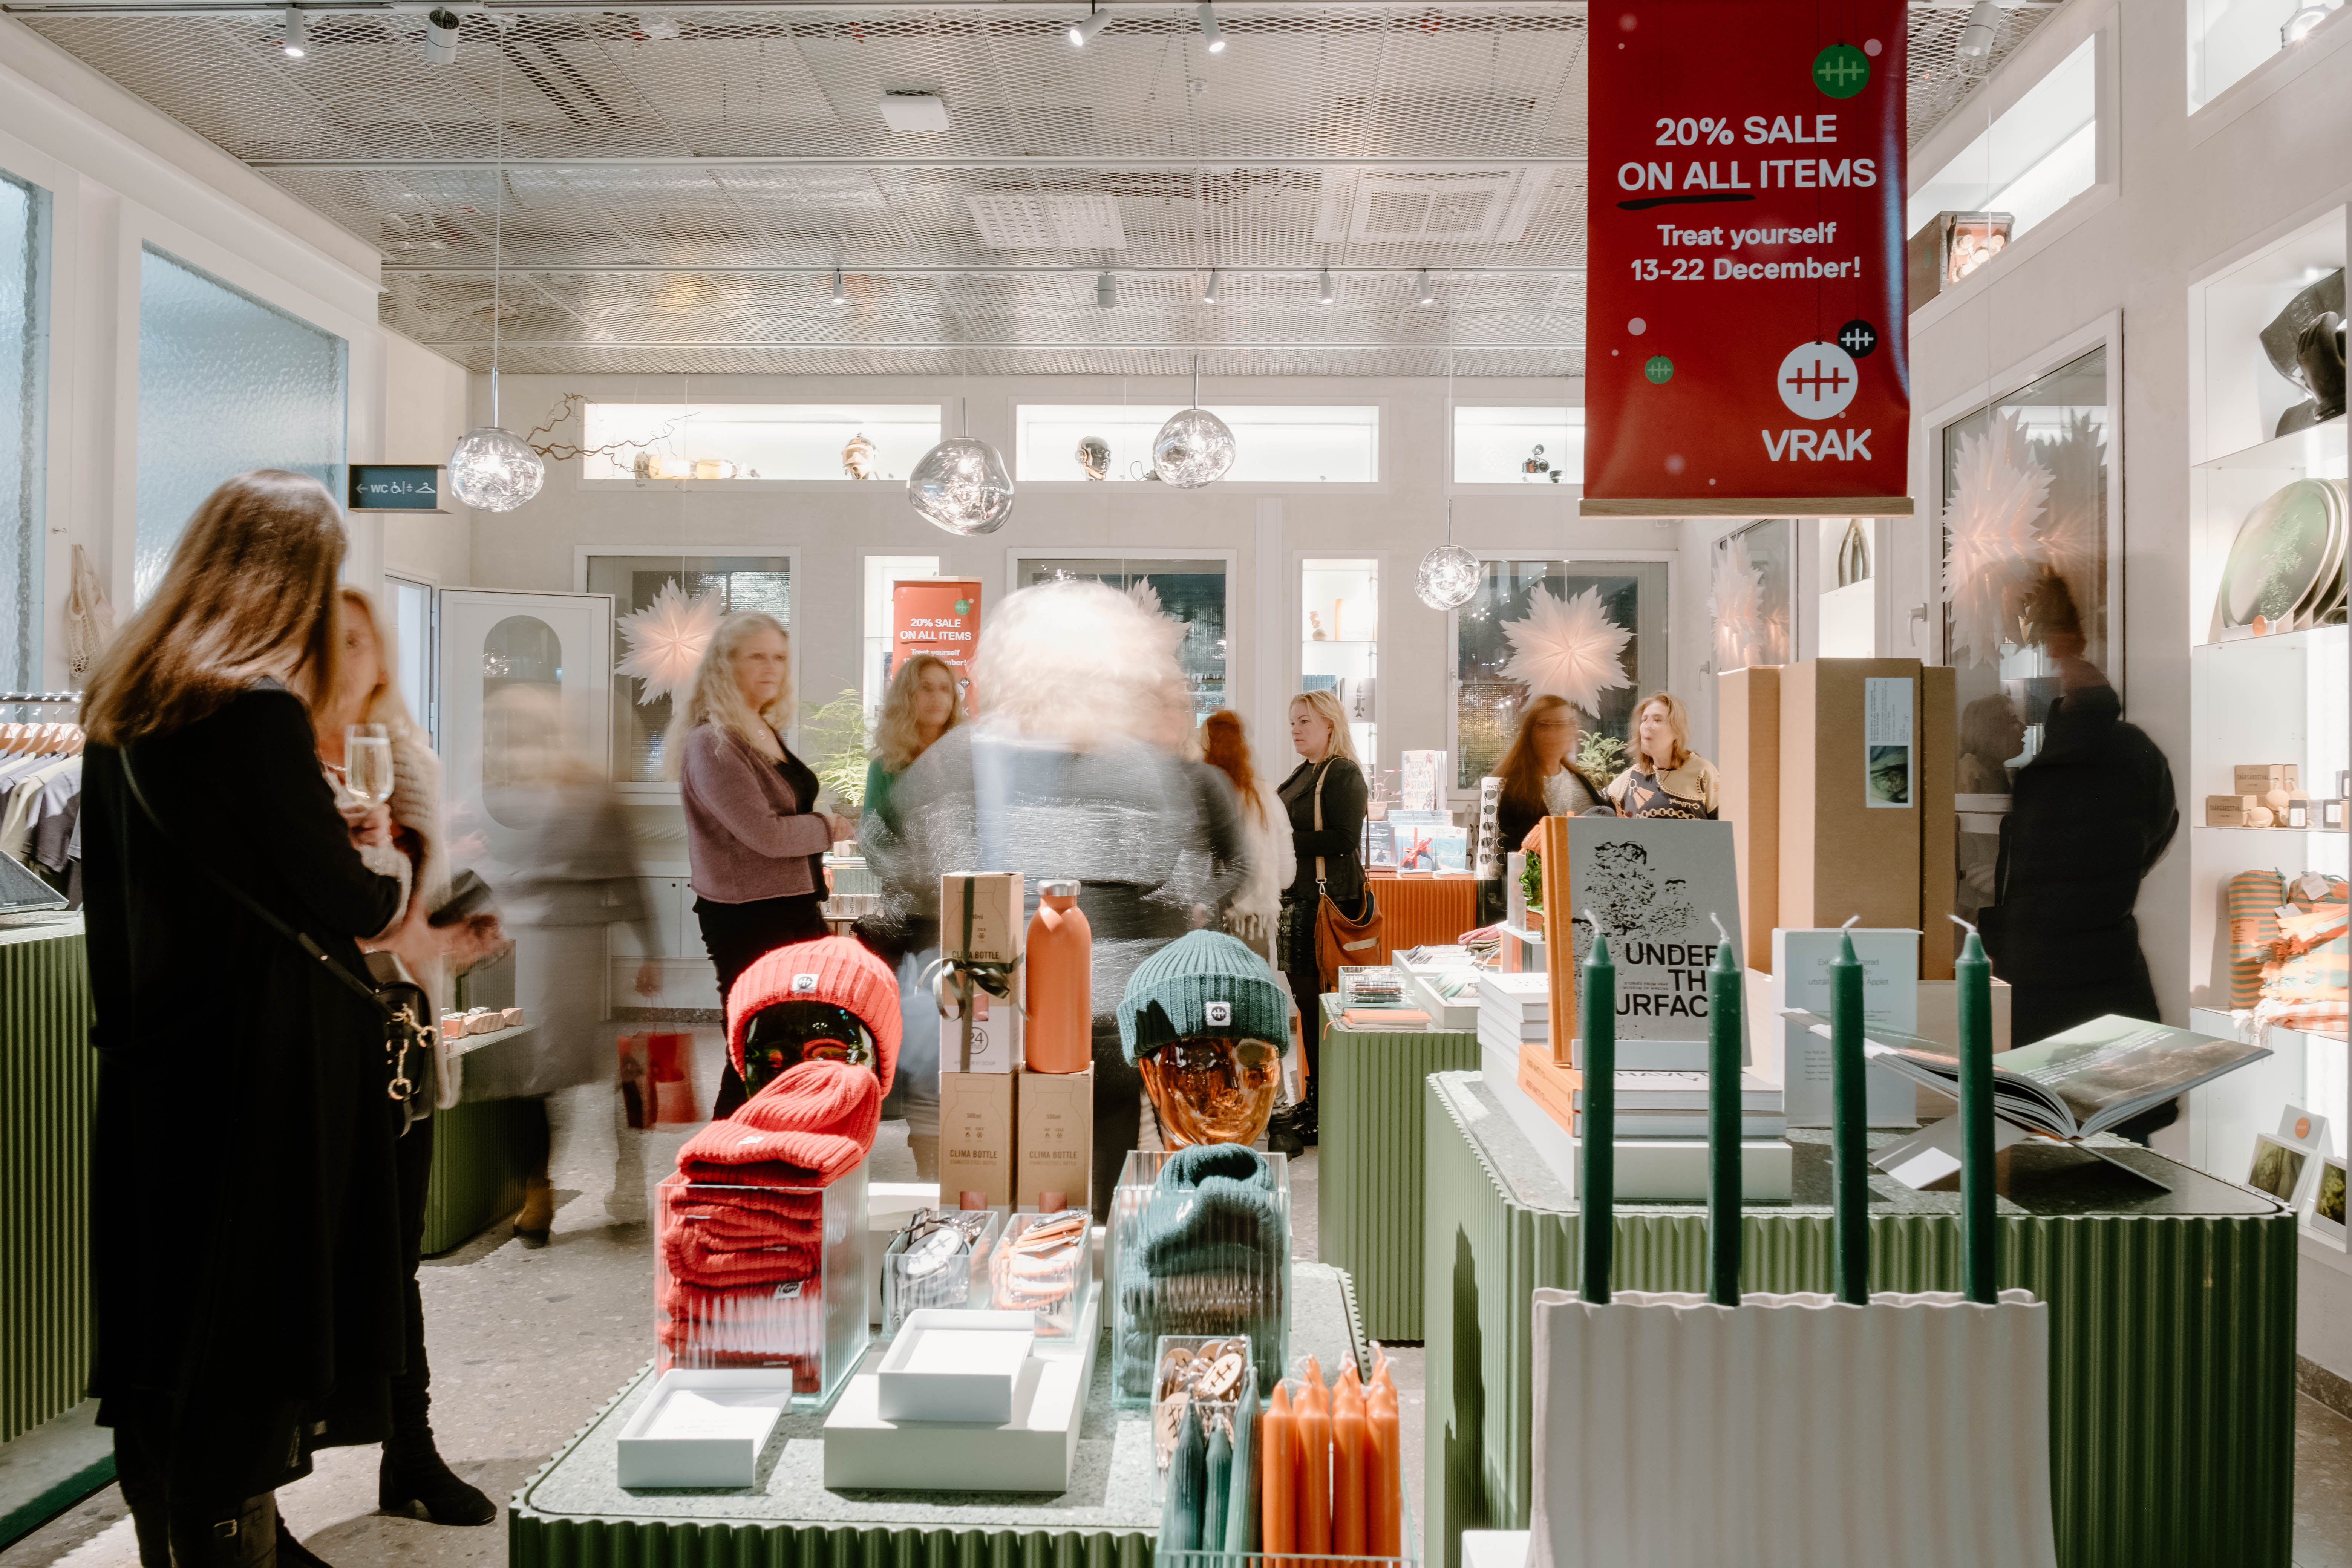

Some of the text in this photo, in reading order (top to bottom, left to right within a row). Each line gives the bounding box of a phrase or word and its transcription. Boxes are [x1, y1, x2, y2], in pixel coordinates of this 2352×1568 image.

[1656, 115, 1837, 146] 20% SALE
[1618, 158, 1876, 191] ON ALL ITEMS
[1657, 222, 1836, 250] Treat yourself
[1631, 256, 1860, 281] 13-22 December!
[1762, 429, 1871, 461] VRAK
[371, 484, 388, 493] WC
[900, 631, 972, 640] ON ALL ITEMS
[910, 618, 961, 628] 20% SALE
[1668, 969, 1707, 992] TH
